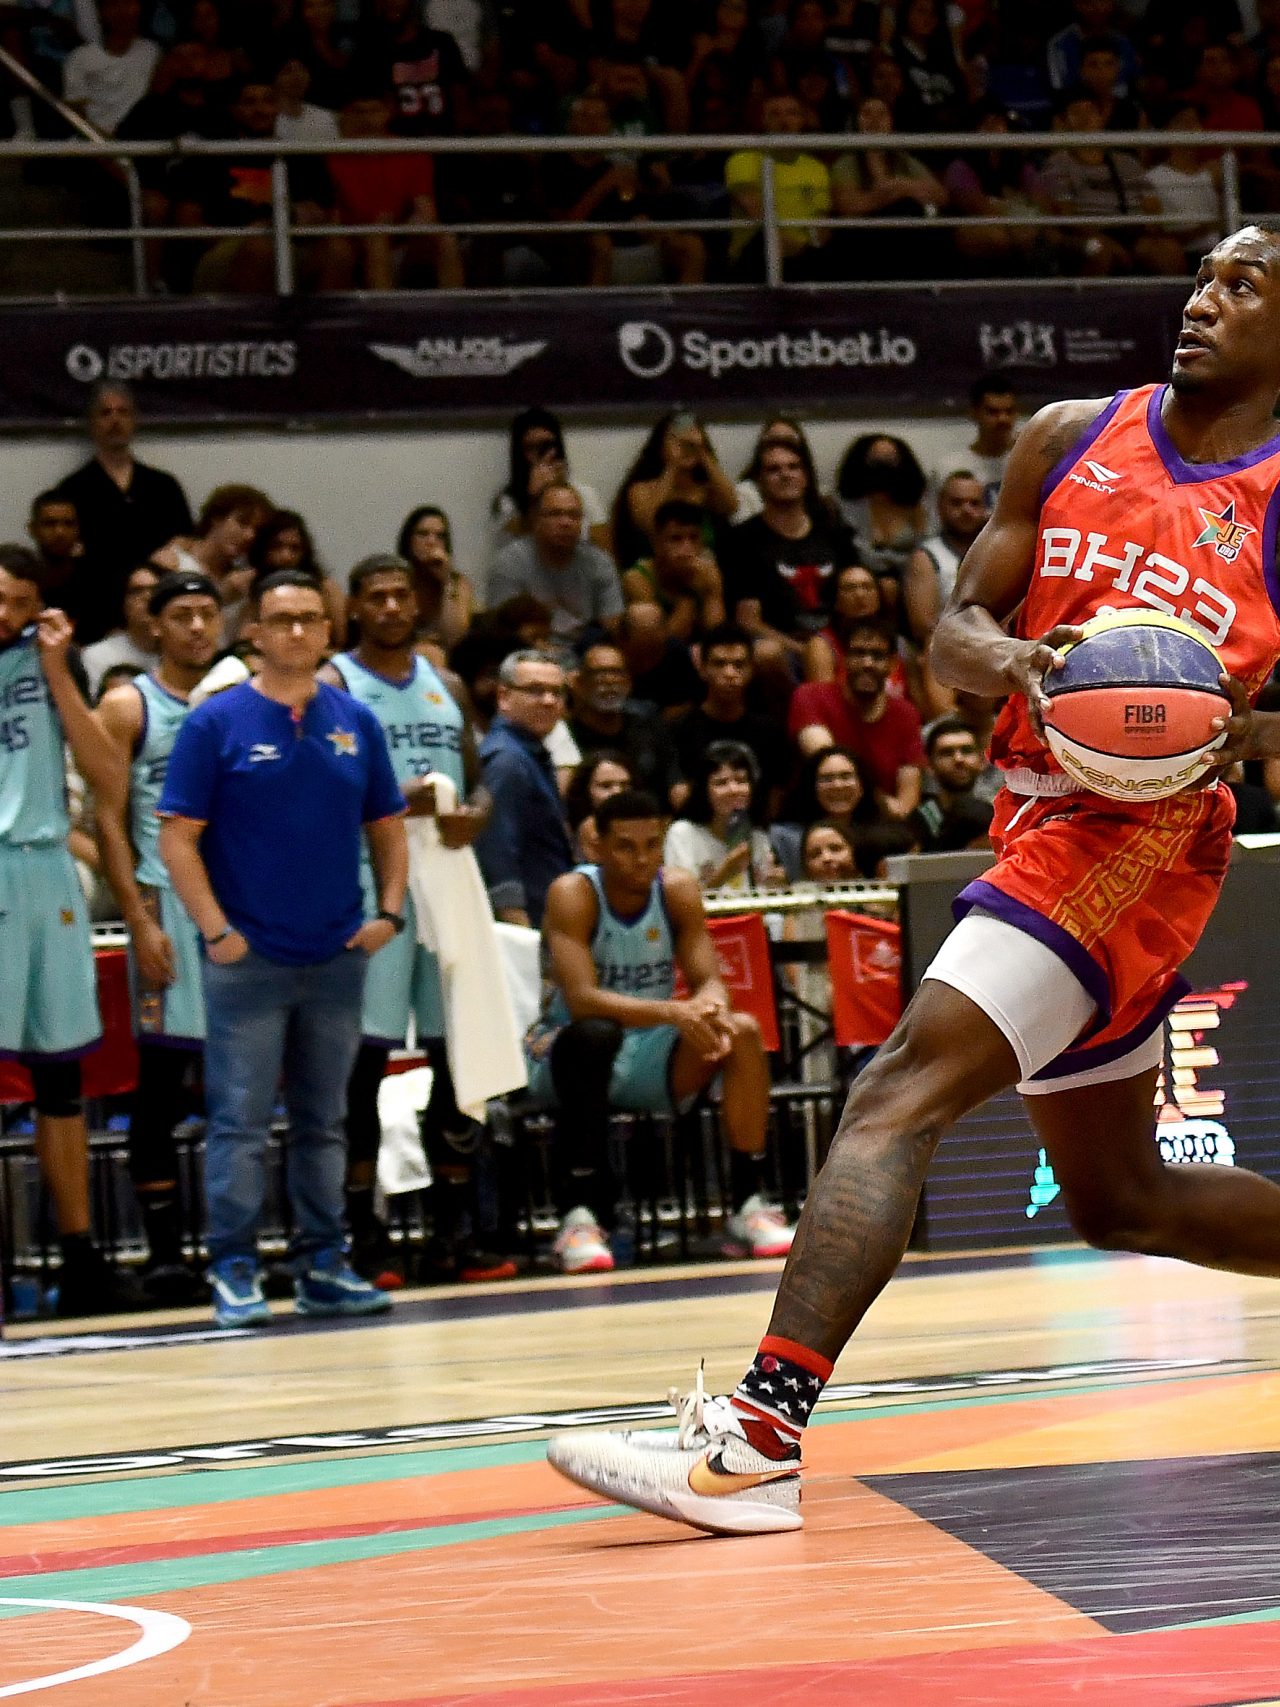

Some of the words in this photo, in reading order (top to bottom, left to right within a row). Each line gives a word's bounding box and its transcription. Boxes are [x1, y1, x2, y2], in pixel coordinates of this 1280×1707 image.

[683, 327, 916, 377] Sportsbet.io
[1069, 473, 1117, 495] PENALTY
[1040, 527, 1238, 648] BH23
[1125, 704, 1166, 724] FIBA
[1061, 748, 1206, 792] PENALT
